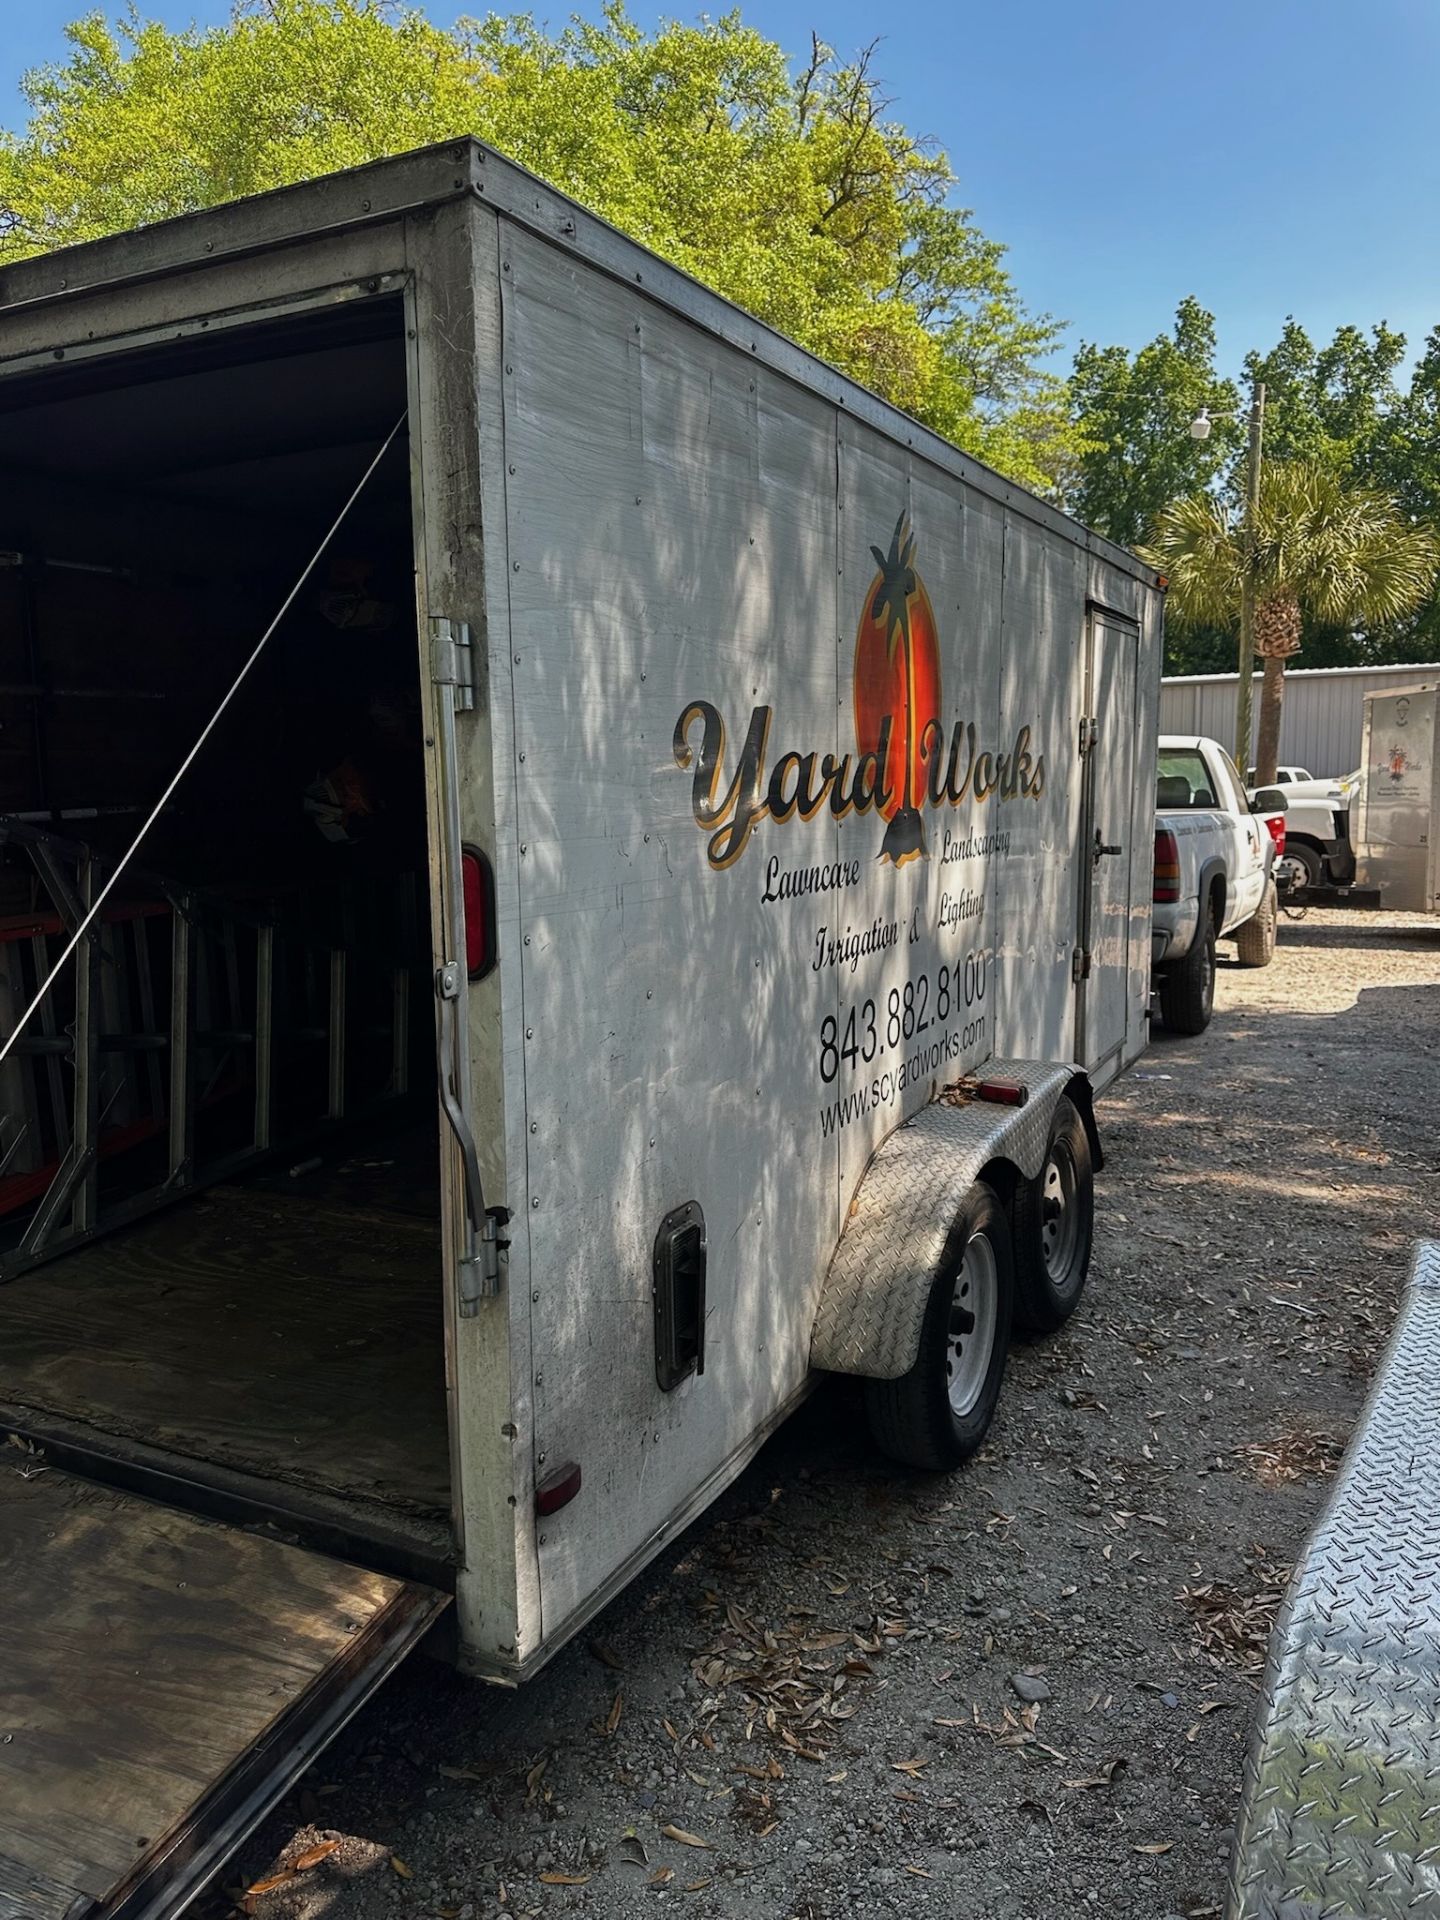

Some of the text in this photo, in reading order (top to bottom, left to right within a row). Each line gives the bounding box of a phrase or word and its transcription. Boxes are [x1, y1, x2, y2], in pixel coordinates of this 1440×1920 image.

[672, 699, 1046, 871] Yard Works
[760, 826, 1011, 905] Lawncare Landscaping
[811, 916, 899, 973] Irrigation
[937, 888, 985, 935] Lighting
[819, 949, 987, 1084] 843.882.8100
[820, 1015, 986, 1138] www.scyardworks.com
